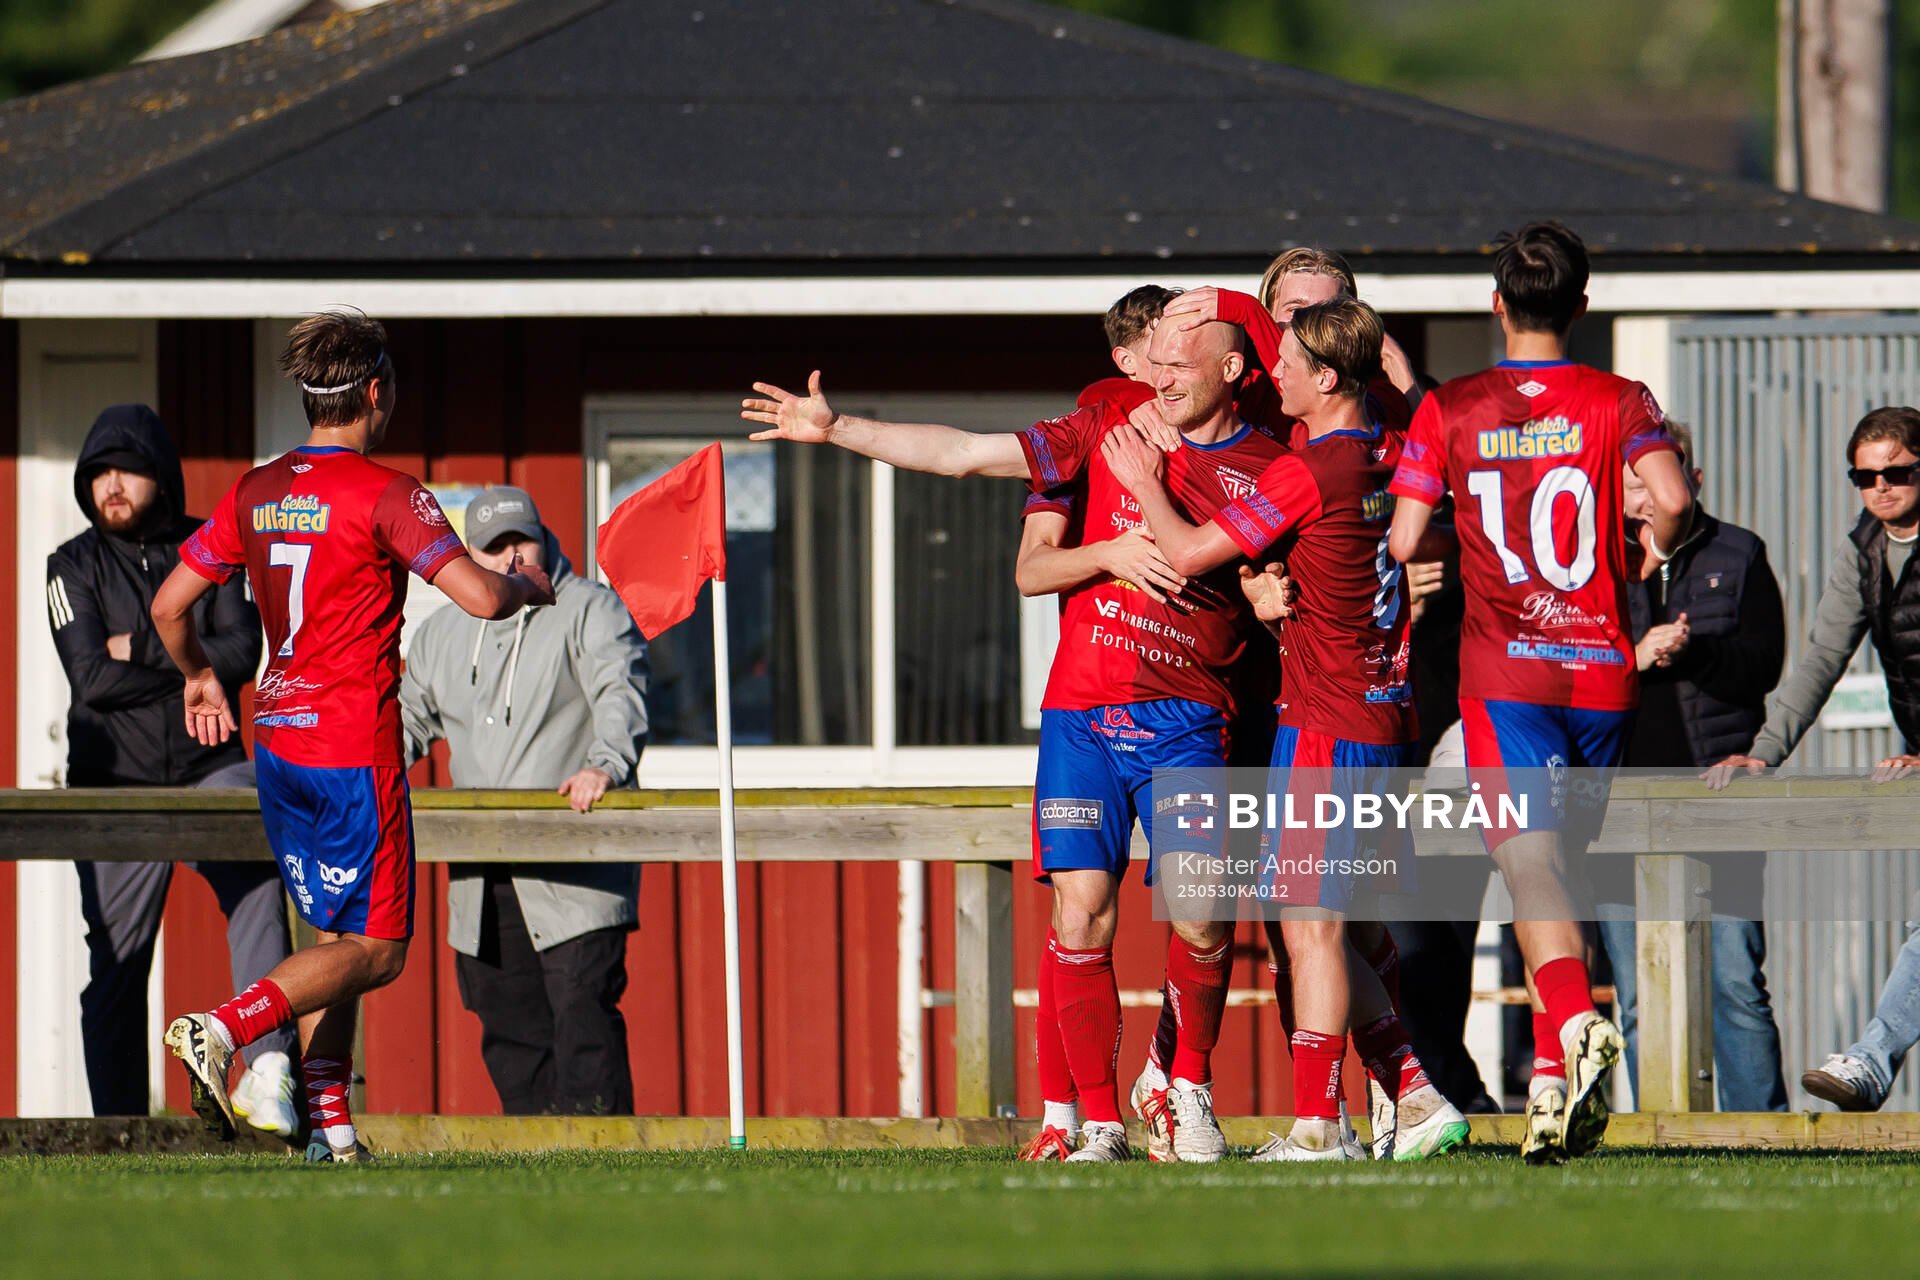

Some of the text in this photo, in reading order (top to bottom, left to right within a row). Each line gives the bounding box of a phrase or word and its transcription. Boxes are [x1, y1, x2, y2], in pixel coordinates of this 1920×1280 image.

[1479, 425, 1581, 459] Ullared
[252, 503, 329, 533] Ullared
[1468, 466, 1597, 592] 10
[269, 543, 312, 656] 7
[1120, 609, 1161, 634] VARBERG
[1163, 625, 1196, 649] ENERGI
[1103, 706, 1135, 729] ICA
[1042, 802, 1098, 819] colorama
